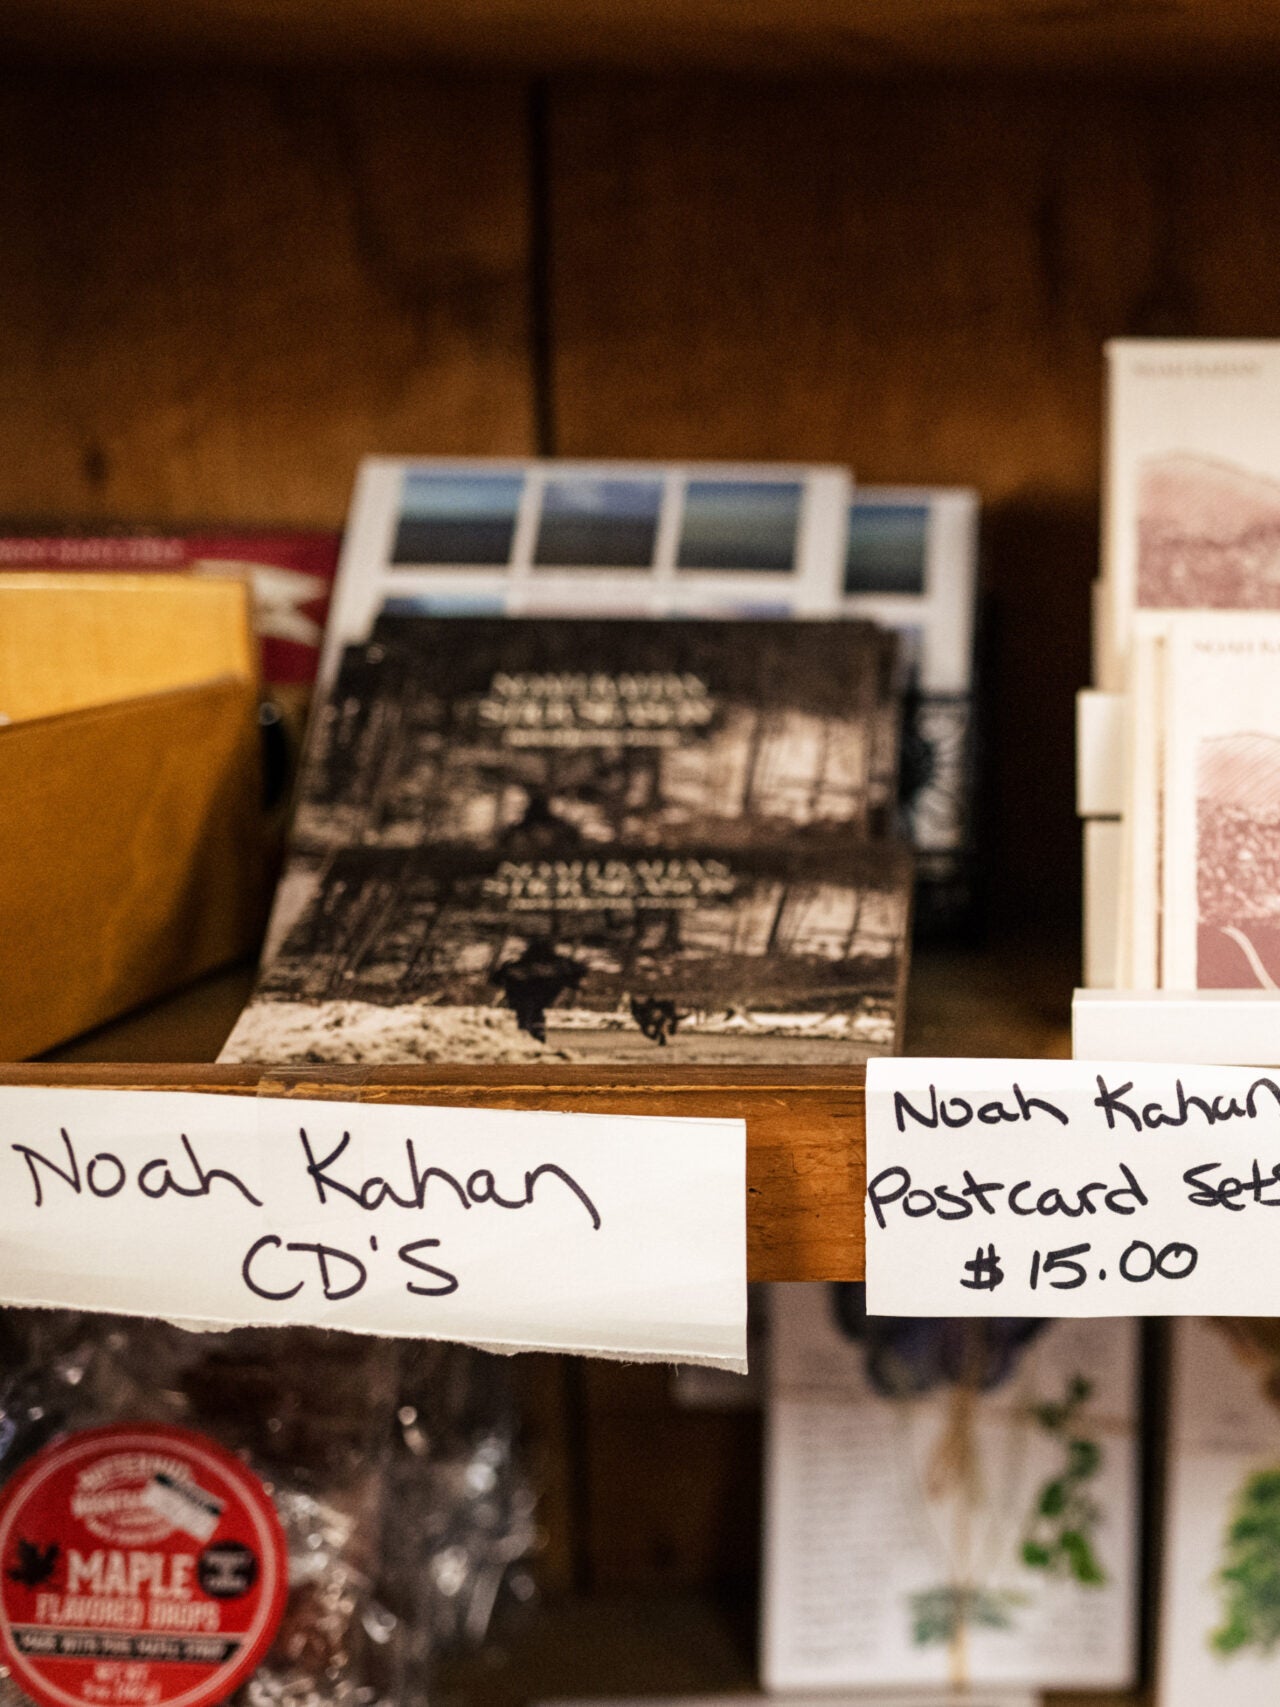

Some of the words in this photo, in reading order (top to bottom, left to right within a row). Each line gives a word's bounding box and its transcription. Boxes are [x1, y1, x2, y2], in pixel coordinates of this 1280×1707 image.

[894, 1084, 1068, 1132] Noah
[12, 1127, 262, 1206] Noah
[300, 1127, 600, 1230] Kahan
[868, 1163, 1148, 1229] Postcard
[67, 1549, 196, 1600] MAPLE
